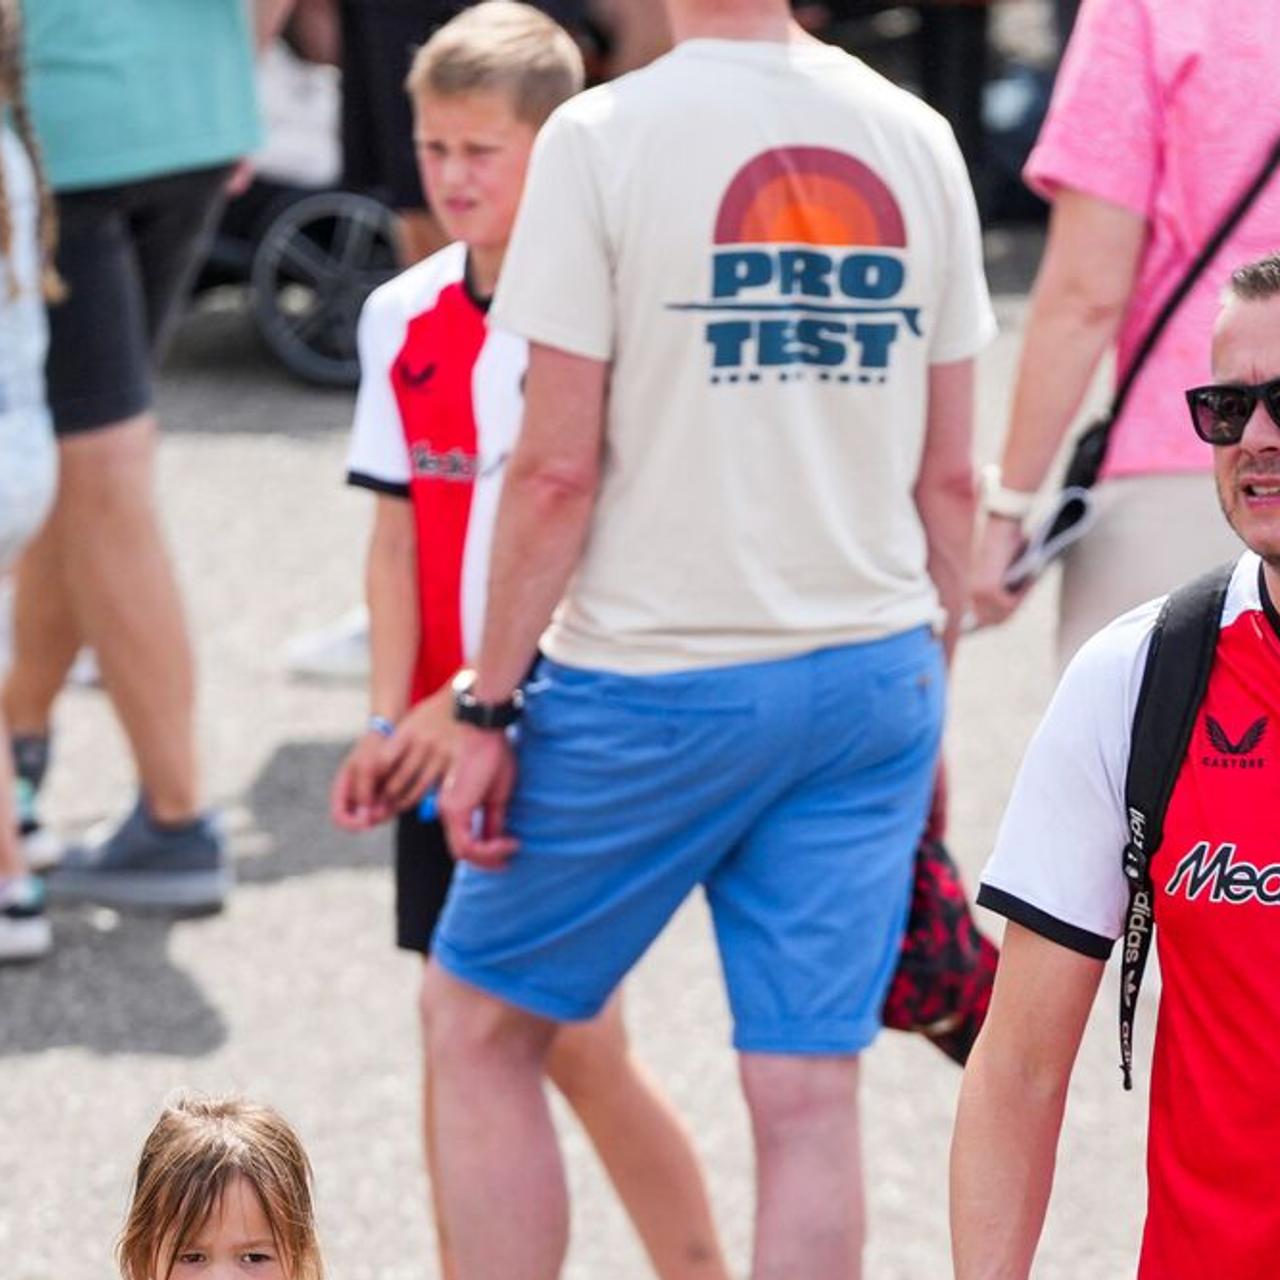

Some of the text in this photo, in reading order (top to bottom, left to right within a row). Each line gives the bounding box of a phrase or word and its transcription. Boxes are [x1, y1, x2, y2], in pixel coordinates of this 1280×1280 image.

[712, 249, 905, 301] PRO
[706, 320, 898, 367] TEST
[1125, 891, 1152, 963] didas
